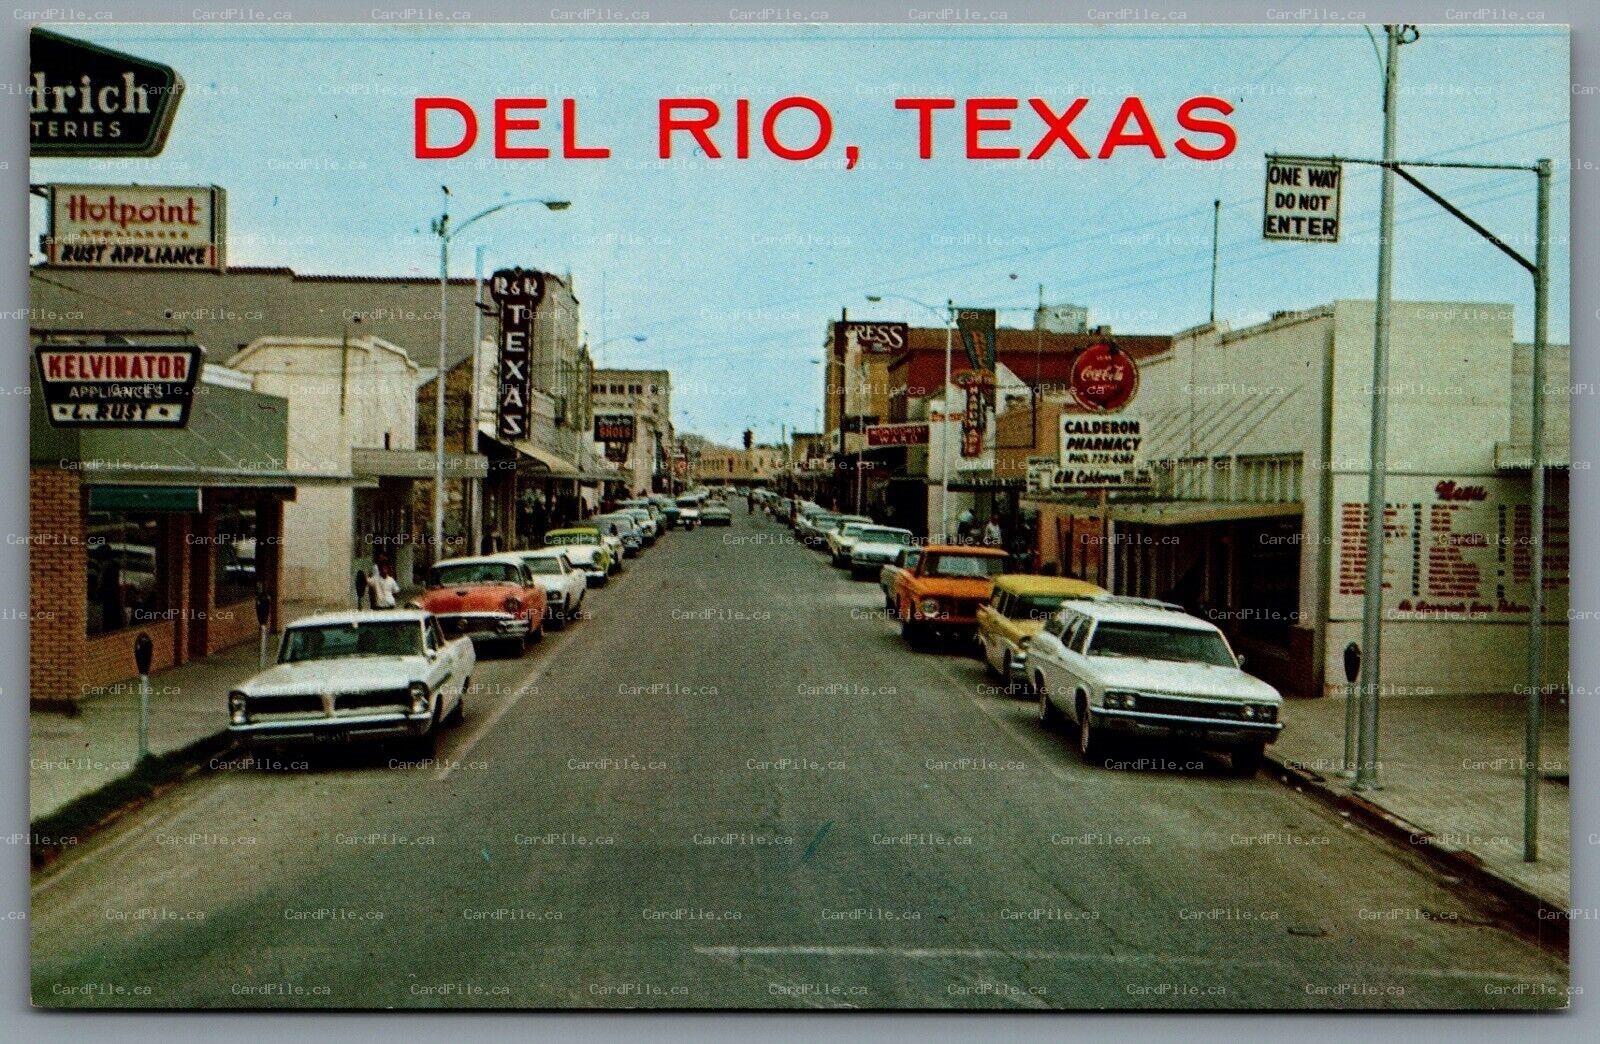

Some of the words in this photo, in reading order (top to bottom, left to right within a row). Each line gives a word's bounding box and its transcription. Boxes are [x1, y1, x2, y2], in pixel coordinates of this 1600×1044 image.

[31, 120, 121, 138] TERIES
[1269, 166, 1301, 186] ONE
[1308, 168, 1338, 189] WAY
[66, 194, 201, 229] Hotpoint
[1275, 192, 1296, 209] DO
[1299, 193, 1330, 211] NOT
[1266, 215, 1337, 236] ENTER
[61, 243, 107, 262] RUST
[110, 244, 206, 265] APPLIANCE
[847, 325, 904, 349] RESS
[48, 354, 187, 379] KELVINATOR
[503, 304, 526, 435] TEXAS
[1065, 421, 1140, 434] CALDERON
[1067, 438, 1141, 451] PHARMACY
[1435, 480, 1487, 501] Menu
